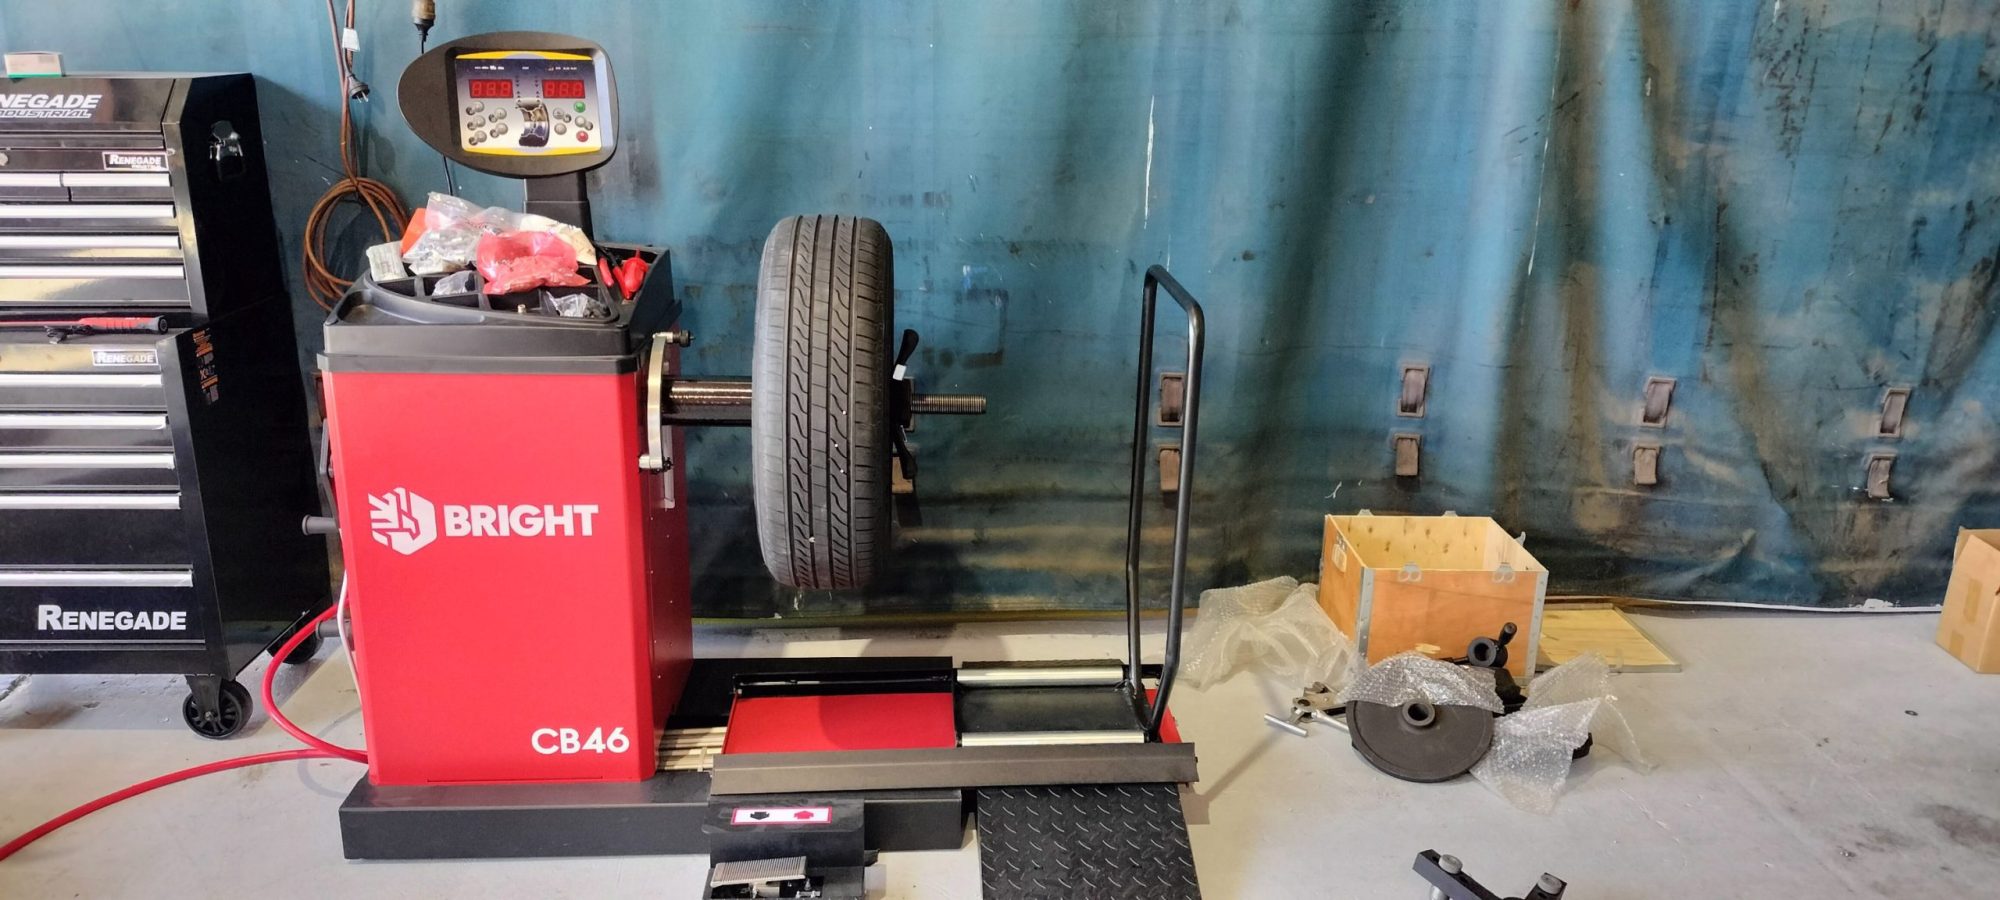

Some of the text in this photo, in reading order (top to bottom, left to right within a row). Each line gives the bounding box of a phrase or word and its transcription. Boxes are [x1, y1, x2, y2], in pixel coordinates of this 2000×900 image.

[109, 154, 161, 164] RENEGADE
[97, 352, 154, 362] RENEGADE
[443, 504, 598, 537] BRIGHT
[38, 604, 187, 631] RENEGADE
[531, 727, 630, 755] CB46
